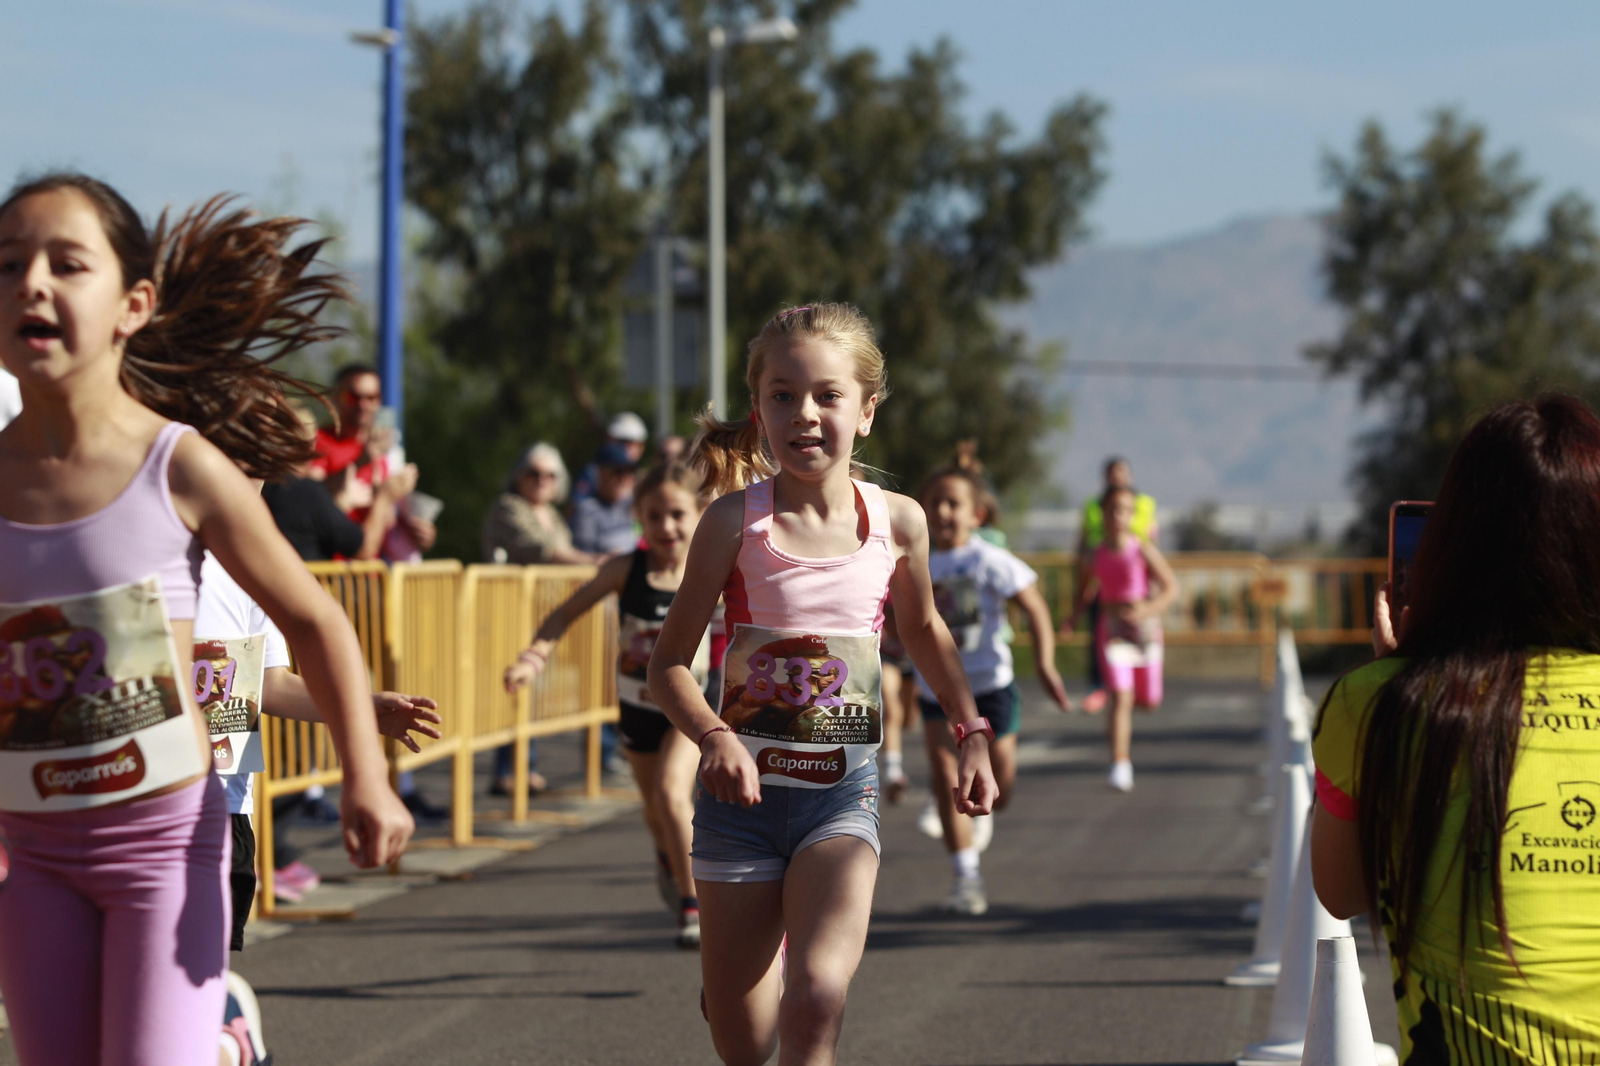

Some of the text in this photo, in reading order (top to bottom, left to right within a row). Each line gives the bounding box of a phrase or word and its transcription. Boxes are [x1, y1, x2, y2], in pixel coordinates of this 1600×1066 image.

[746, 652, 848, 706] 832
[213, 697, 247, 711] XIII
[211, 708, 248, 718] CARRERA
[814, 705, 869, 717] XIII
[211, 715, 247, 724] POPULAR
[831, 735, 867, 743] ALQUIÁN
